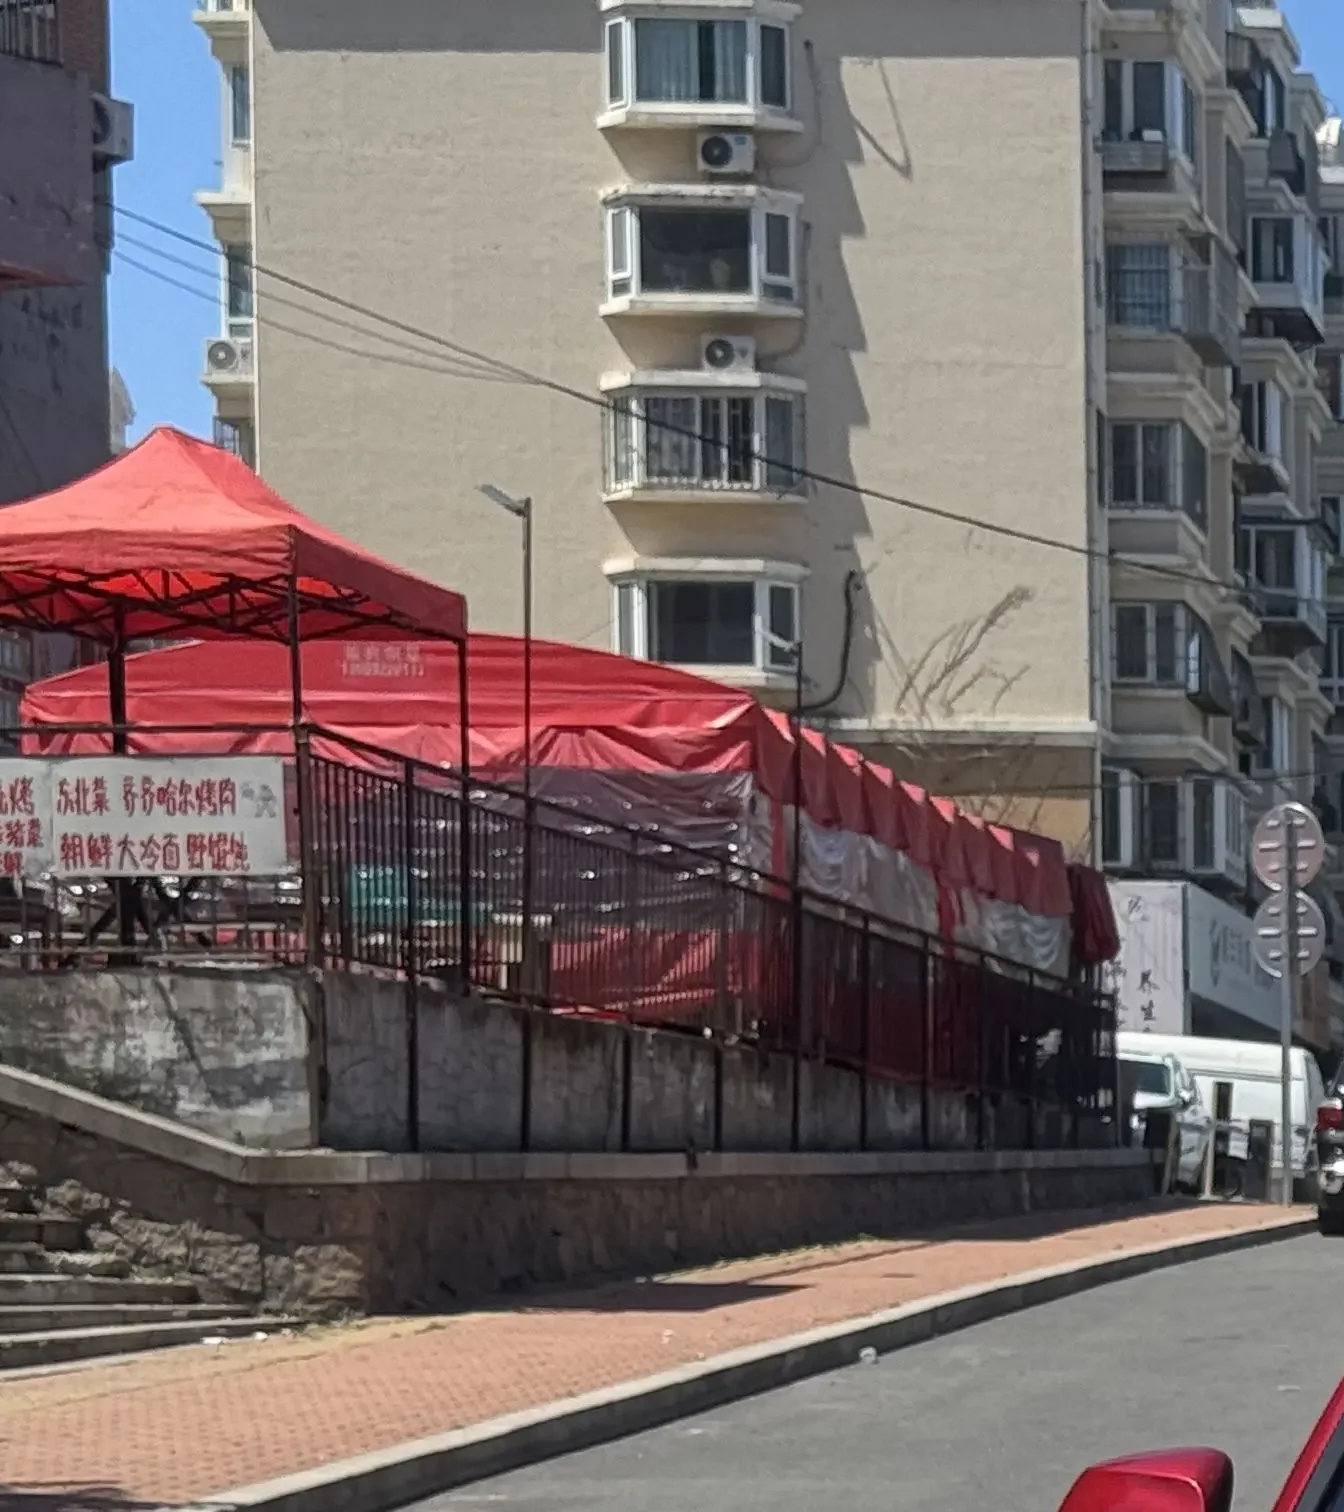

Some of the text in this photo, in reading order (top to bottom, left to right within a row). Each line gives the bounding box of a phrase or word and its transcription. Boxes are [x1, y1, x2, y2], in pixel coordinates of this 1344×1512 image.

[57, 775, 237, 817] 东北菜 齐齐哈尔烤肉
[60, 833, 181, 872] 朝鲜大冷面
